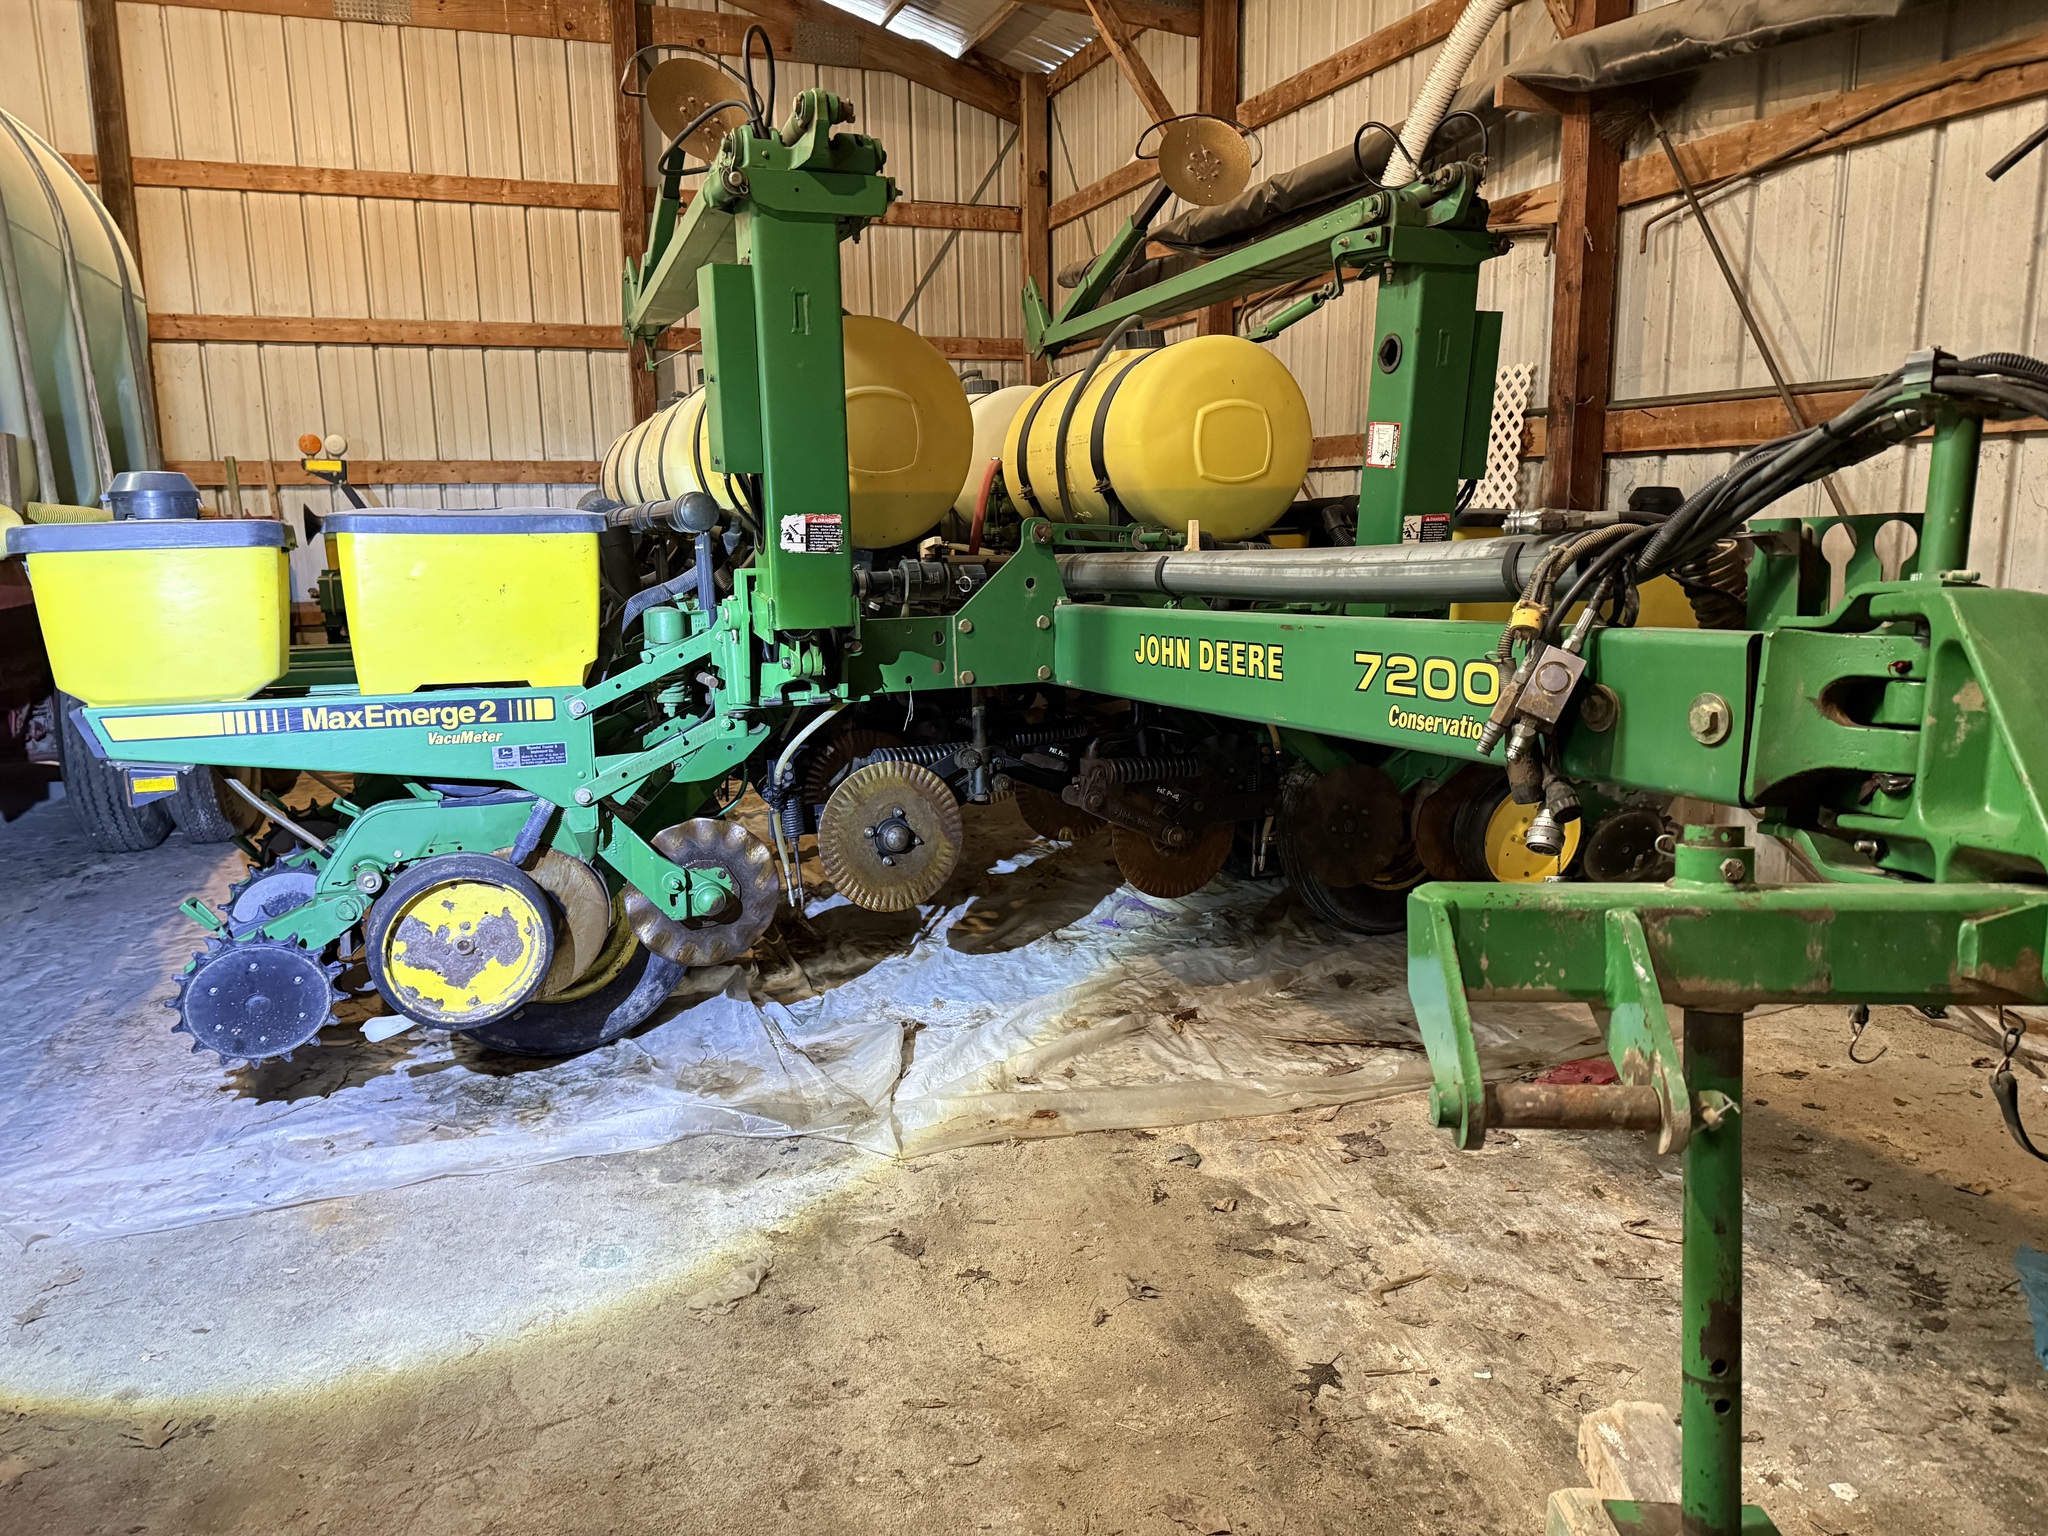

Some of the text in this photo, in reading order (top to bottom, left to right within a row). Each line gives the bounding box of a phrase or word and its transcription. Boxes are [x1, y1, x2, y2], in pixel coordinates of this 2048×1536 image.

[1134, 633, 1284, 682] JOHN DEERE
[1353, 650, 1501, 707] 7200
[301, 700, 497, 731] MaxEmerge 2
[1387, 703, 1486, 741] Conservatio
[427, 730, 504, 746] VacuMeter
